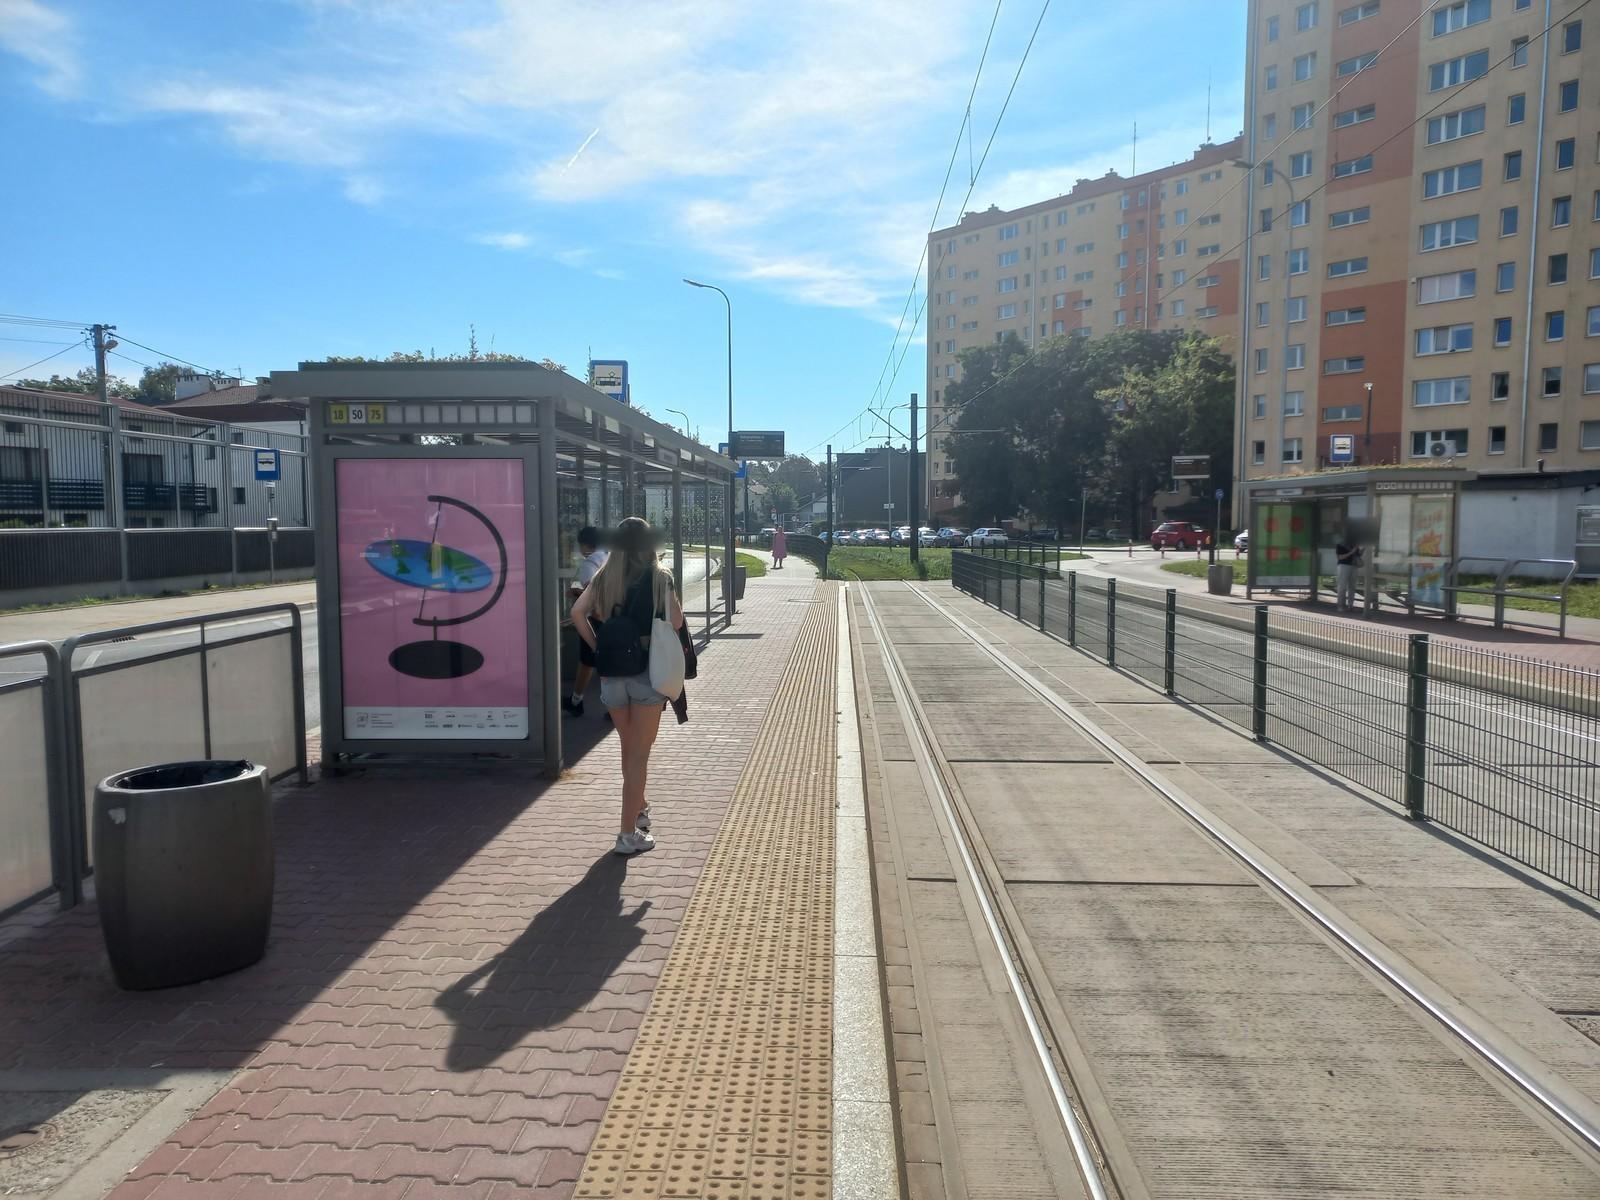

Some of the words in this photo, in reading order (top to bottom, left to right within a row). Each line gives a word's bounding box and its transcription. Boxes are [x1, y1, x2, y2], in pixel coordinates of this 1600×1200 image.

[333, 409, 344, 420] 18
[352, 409, 363, 420] 50
[370, 409, 382, 420] 75
